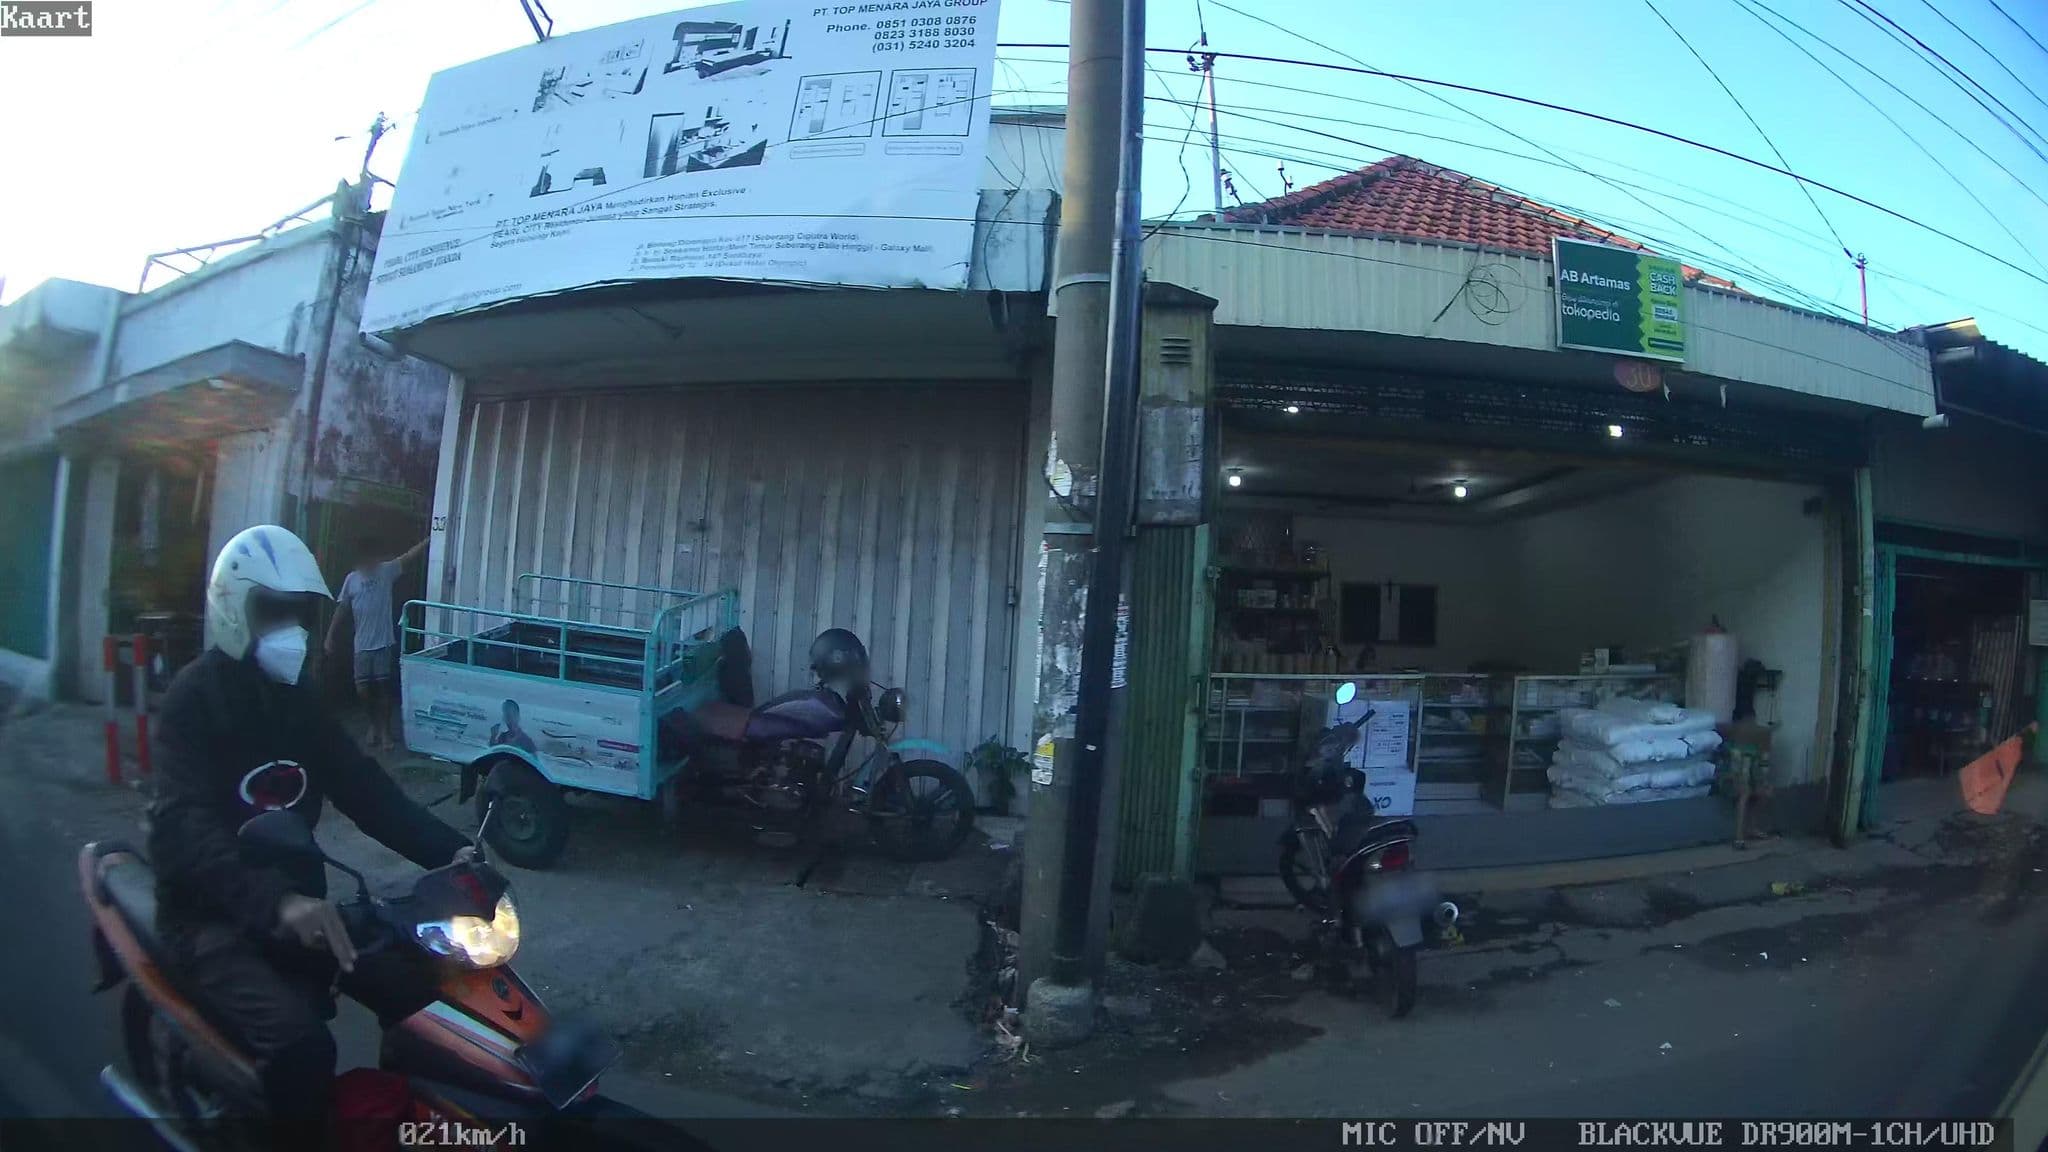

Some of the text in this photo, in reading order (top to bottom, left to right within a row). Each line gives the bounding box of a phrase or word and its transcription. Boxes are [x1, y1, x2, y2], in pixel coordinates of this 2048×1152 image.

[833, 5, 856, 15] TOP
[858, 2, 909, 13] MENARA
[912, 0, 941, 10] JAYA
[944, 0, 988, 8] GROUP
[876, 19, 906, 29] 0851
[911, 17, 942, 27] 0308
[946, 15, 977, 25] 0876
[874, 27, 975, 40] 0823 3188 8030
[872, 38, 975, 53] (031) 5240 3204
[576, 202, 603, 214] JAYA
[701, 186, 746, 198] Exclusive
[1561, 269, 1631, 291] AB Artamas
[1650, 271, 1676, 286] CASH
[1650, 282, 1677, 296] BACK
[1563, 303, 1621, 322] tokopedia
